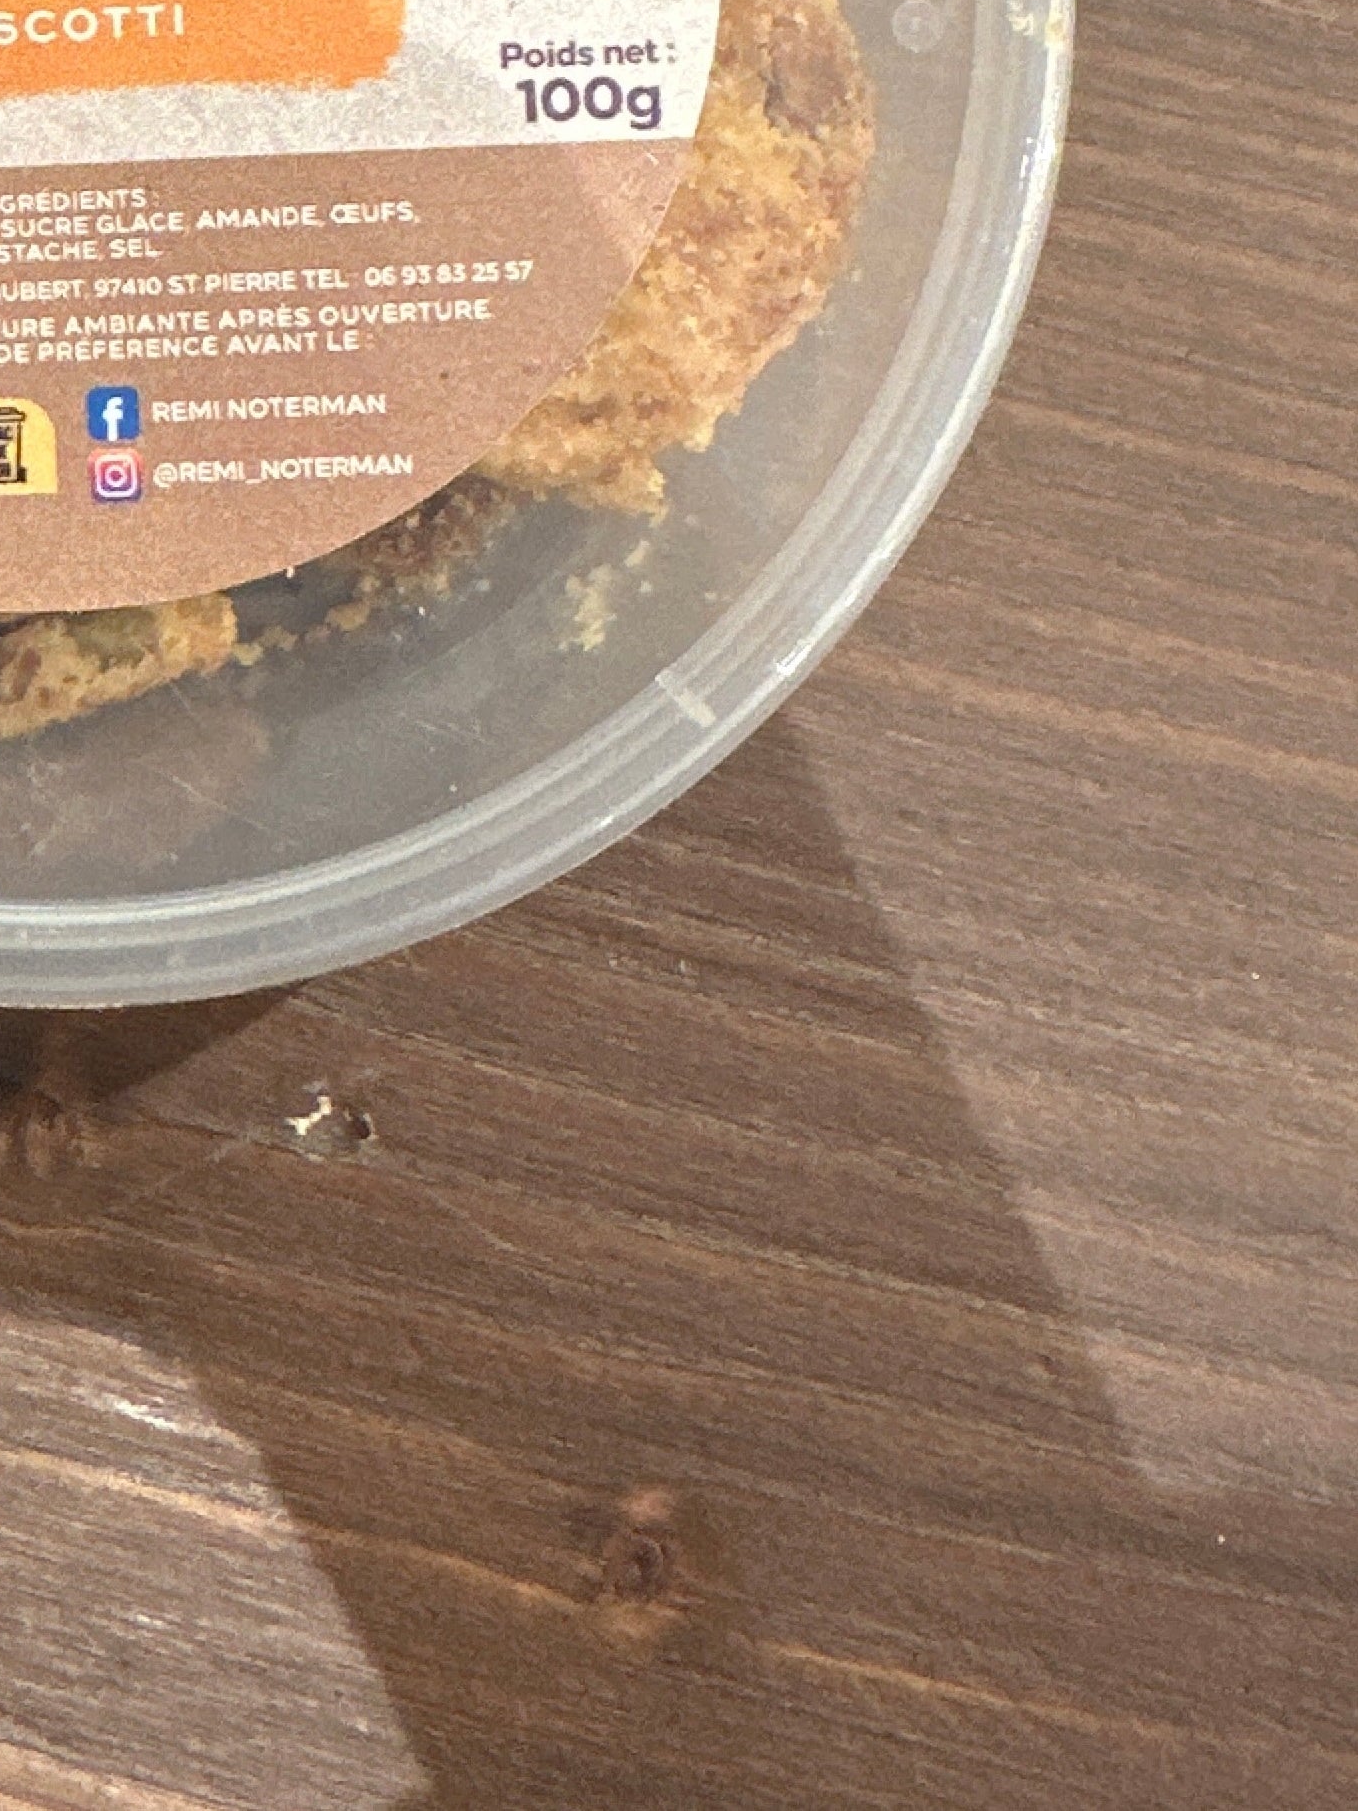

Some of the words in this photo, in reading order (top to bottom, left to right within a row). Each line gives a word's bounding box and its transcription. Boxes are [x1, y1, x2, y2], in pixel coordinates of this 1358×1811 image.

[500, 40, 595, 69] Poids
[515, 76, 662, 130] 100g
[0, 215, 92, 238] SUCRE
[95, 277, 162, 298] 97410
[167, 274, 200, 294] ST
[205, 270, 297, 293] PIERRE
[364, 266, 397, 287] 06
[401, 264, 431, 286] 93
[437, 263, 466, 284] 83
[471, 261, 499, 283] 25
[505, 260, 534, 281] 57
[64, 310, 210, 337] AMBIANTE
[219, 303, 311, 330] APRÈS
[226, 331, 318, 357] AVANT
[326, 329, 360, 352] LE
[152, 400, 220, 423] REMI
[227, 394, 387, 419] NOTERMAN
[153, 454, 414, 490] @REMI_NOTERMAN
